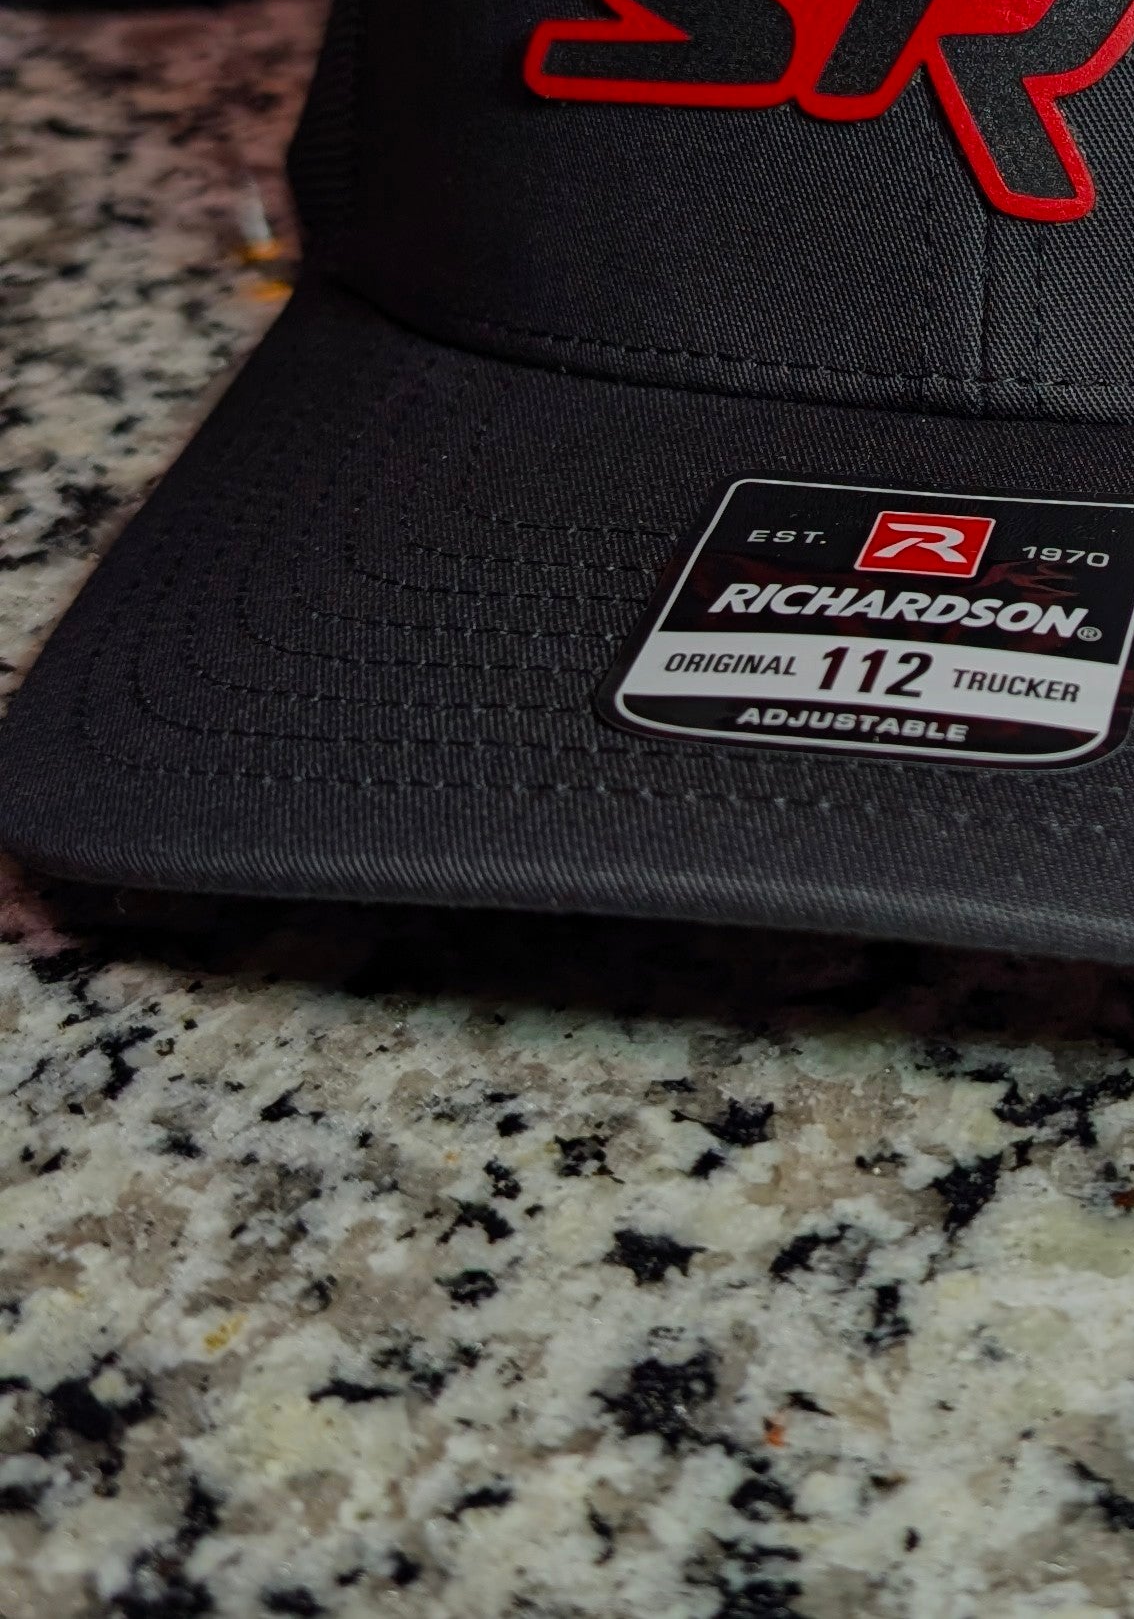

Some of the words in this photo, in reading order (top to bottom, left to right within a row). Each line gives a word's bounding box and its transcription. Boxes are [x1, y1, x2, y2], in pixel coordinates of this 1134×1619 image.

[746, 528, 828, 545] EST.
[1021, 544, 1111, 568] 1970
[664, 652, 798, 677] ORIGINAL
[818, 645, 935, 699] 112
[951, 667, 1081, 704] TRUCKER
[736, 706, 970, 743] ADJUSTABLE
